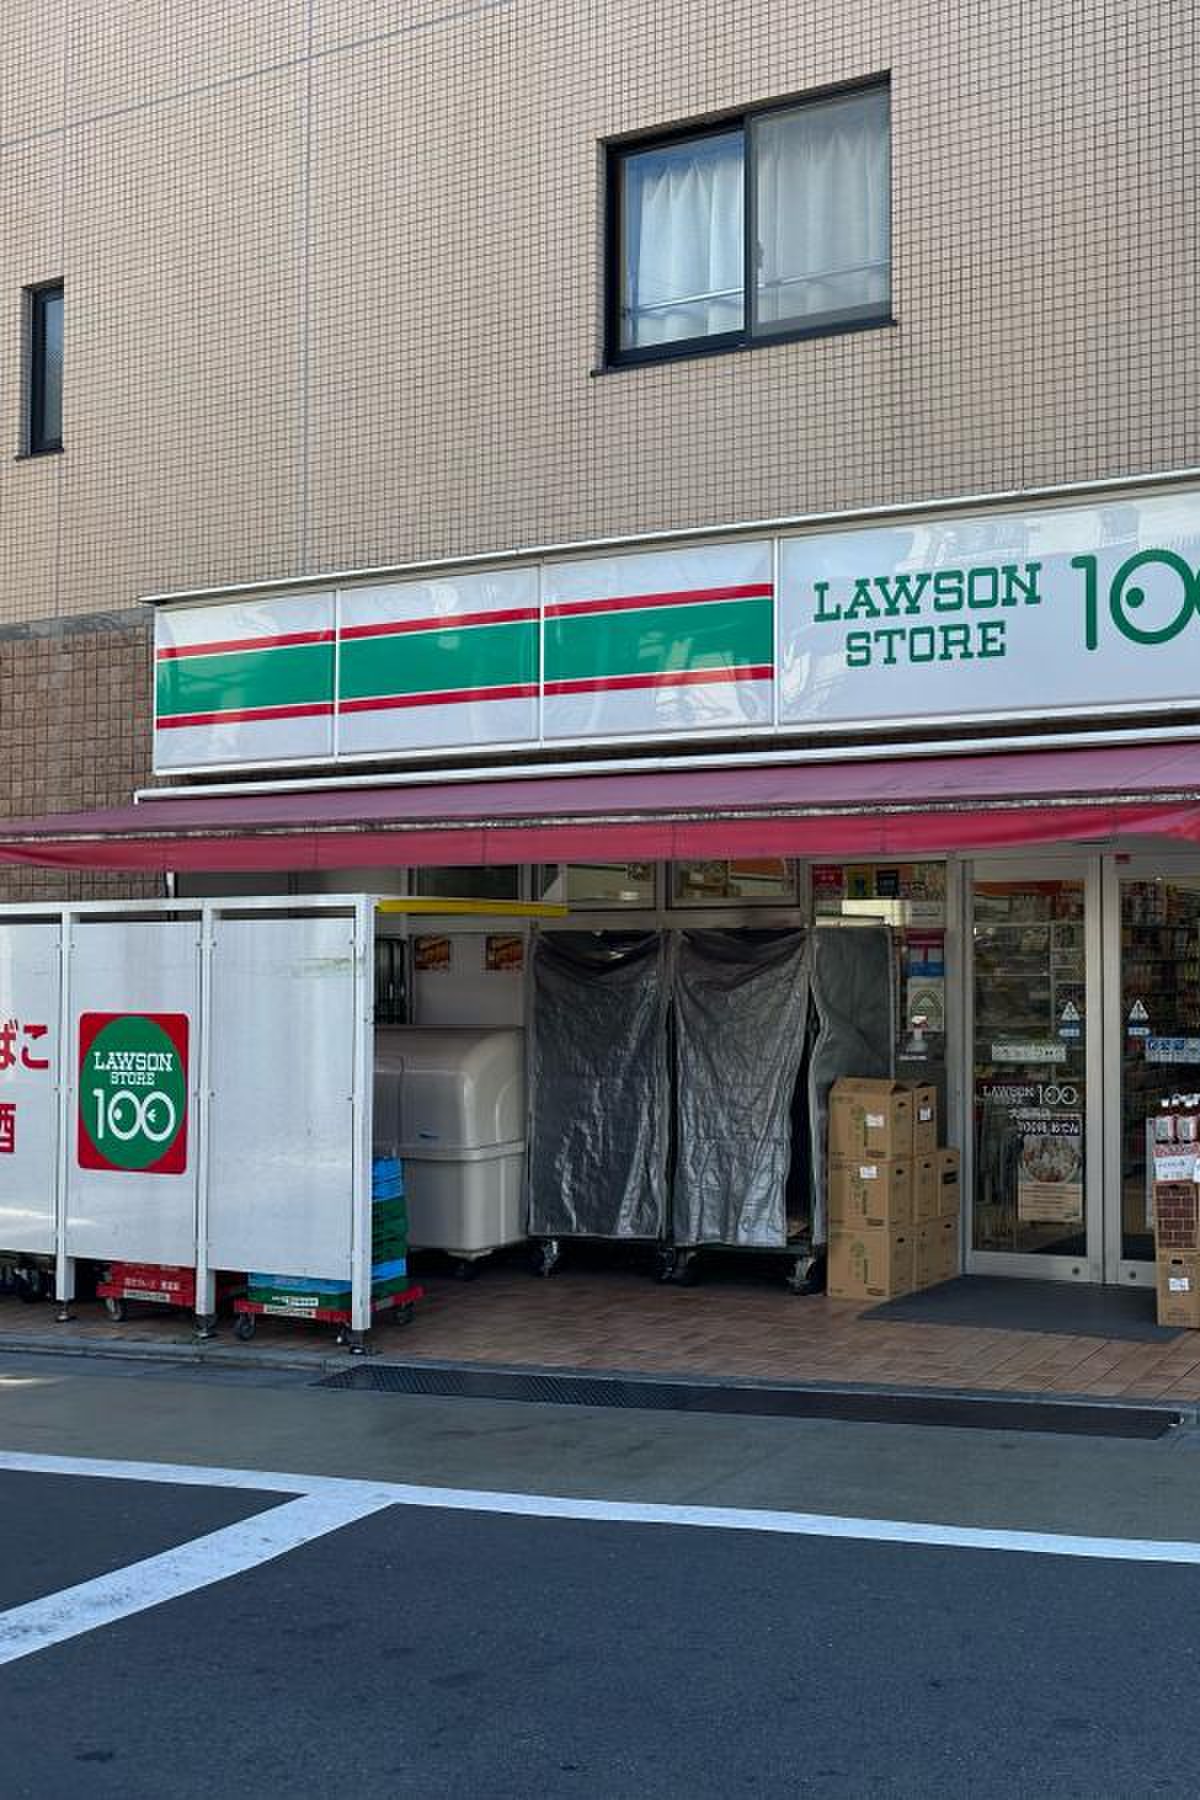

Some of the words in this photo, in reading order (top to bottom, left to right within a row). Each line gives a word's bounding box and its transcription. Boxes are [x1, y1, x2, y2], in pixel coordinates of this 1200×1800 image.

[814, 562, 1042, 622] LAWSON
[846, 621, 1006, 667] STORE
[93, 1052, 173, 1071] LAWSON
[111, 1072, 155, 1085] STORE
[93, 1089, 176, 1141] 100
